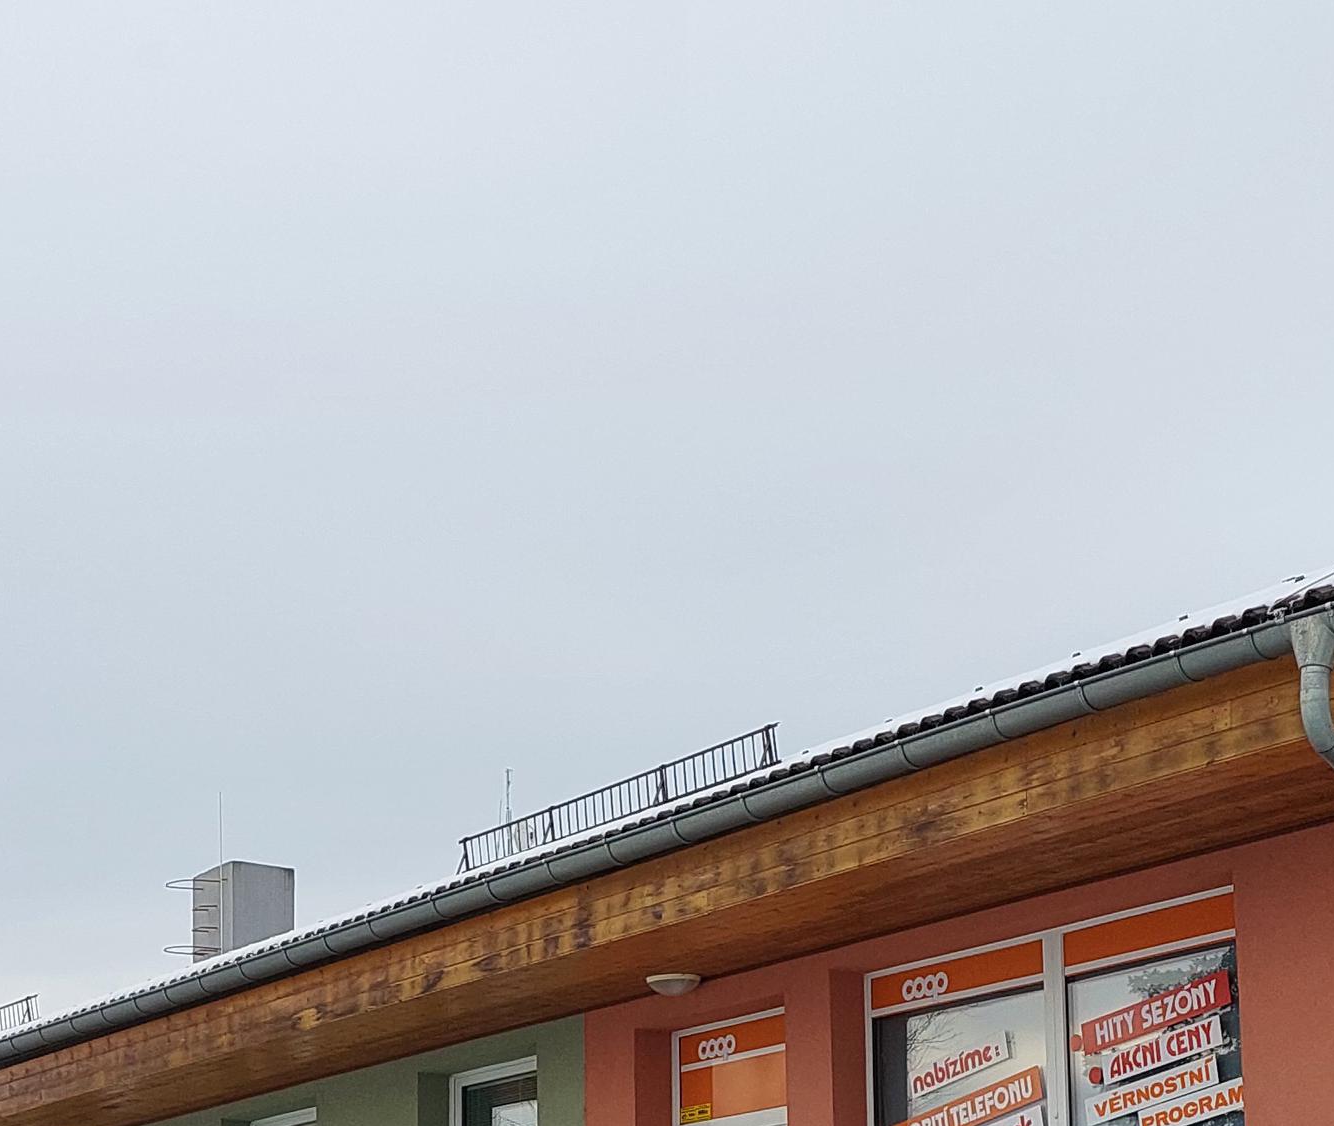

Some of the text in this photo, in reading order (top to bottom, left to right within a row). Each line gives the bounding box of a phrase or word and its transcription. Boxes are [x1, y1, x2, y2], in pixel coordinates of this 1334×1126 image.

[902, 971, 948, 1001] coop
[1094, 979, 1217, 1046] HITY SEZÓNY
[698, 1034, 736, 1061] coop
[1110, 1021, 1214, 1080] AKČNÍ CENY
[1093, 1056, 1215, 1118] VĚRNOSTNÍ
